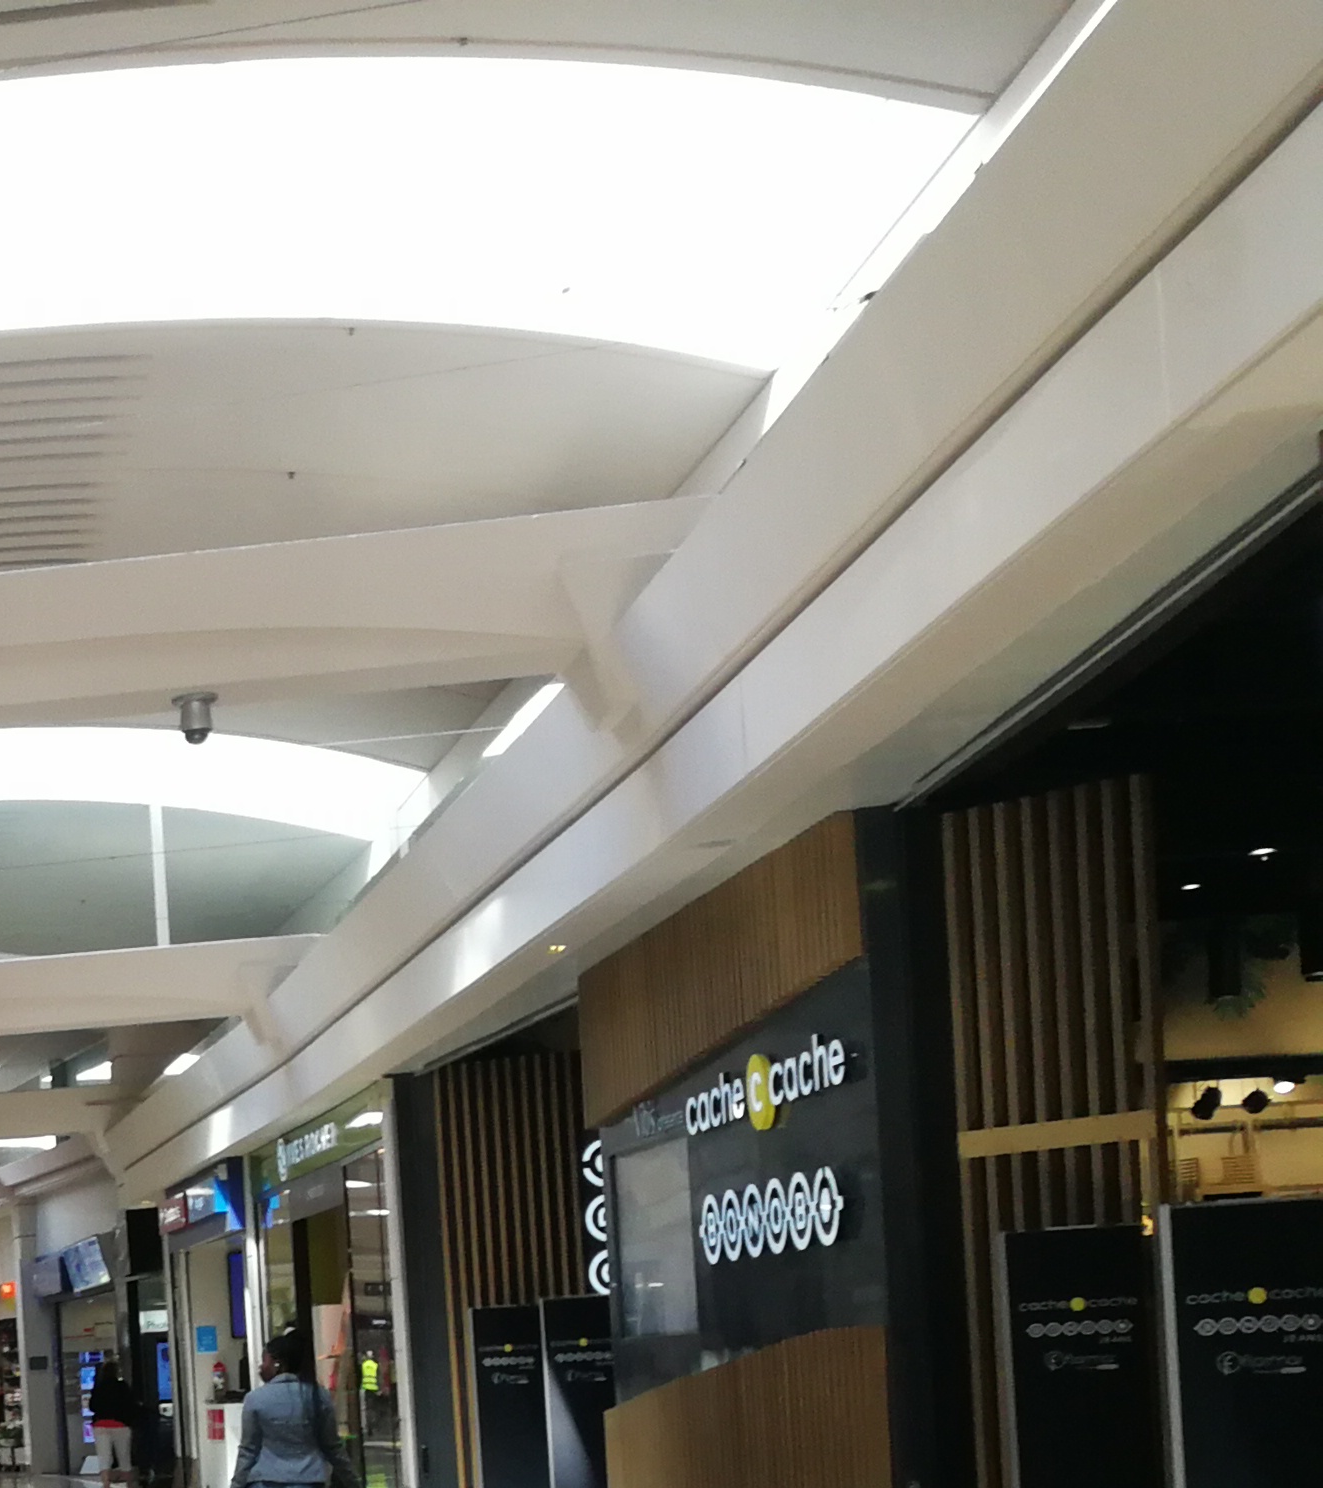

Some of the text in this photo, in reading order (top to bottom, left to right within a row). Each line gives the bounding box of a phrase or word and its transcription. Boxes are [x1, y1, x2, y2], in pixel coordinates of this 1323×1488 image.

[685, 1072, 745, 1136] cache
[768, 1033, 846, 1106] cache
[700, 1167, 844, 1264] BONOBO
